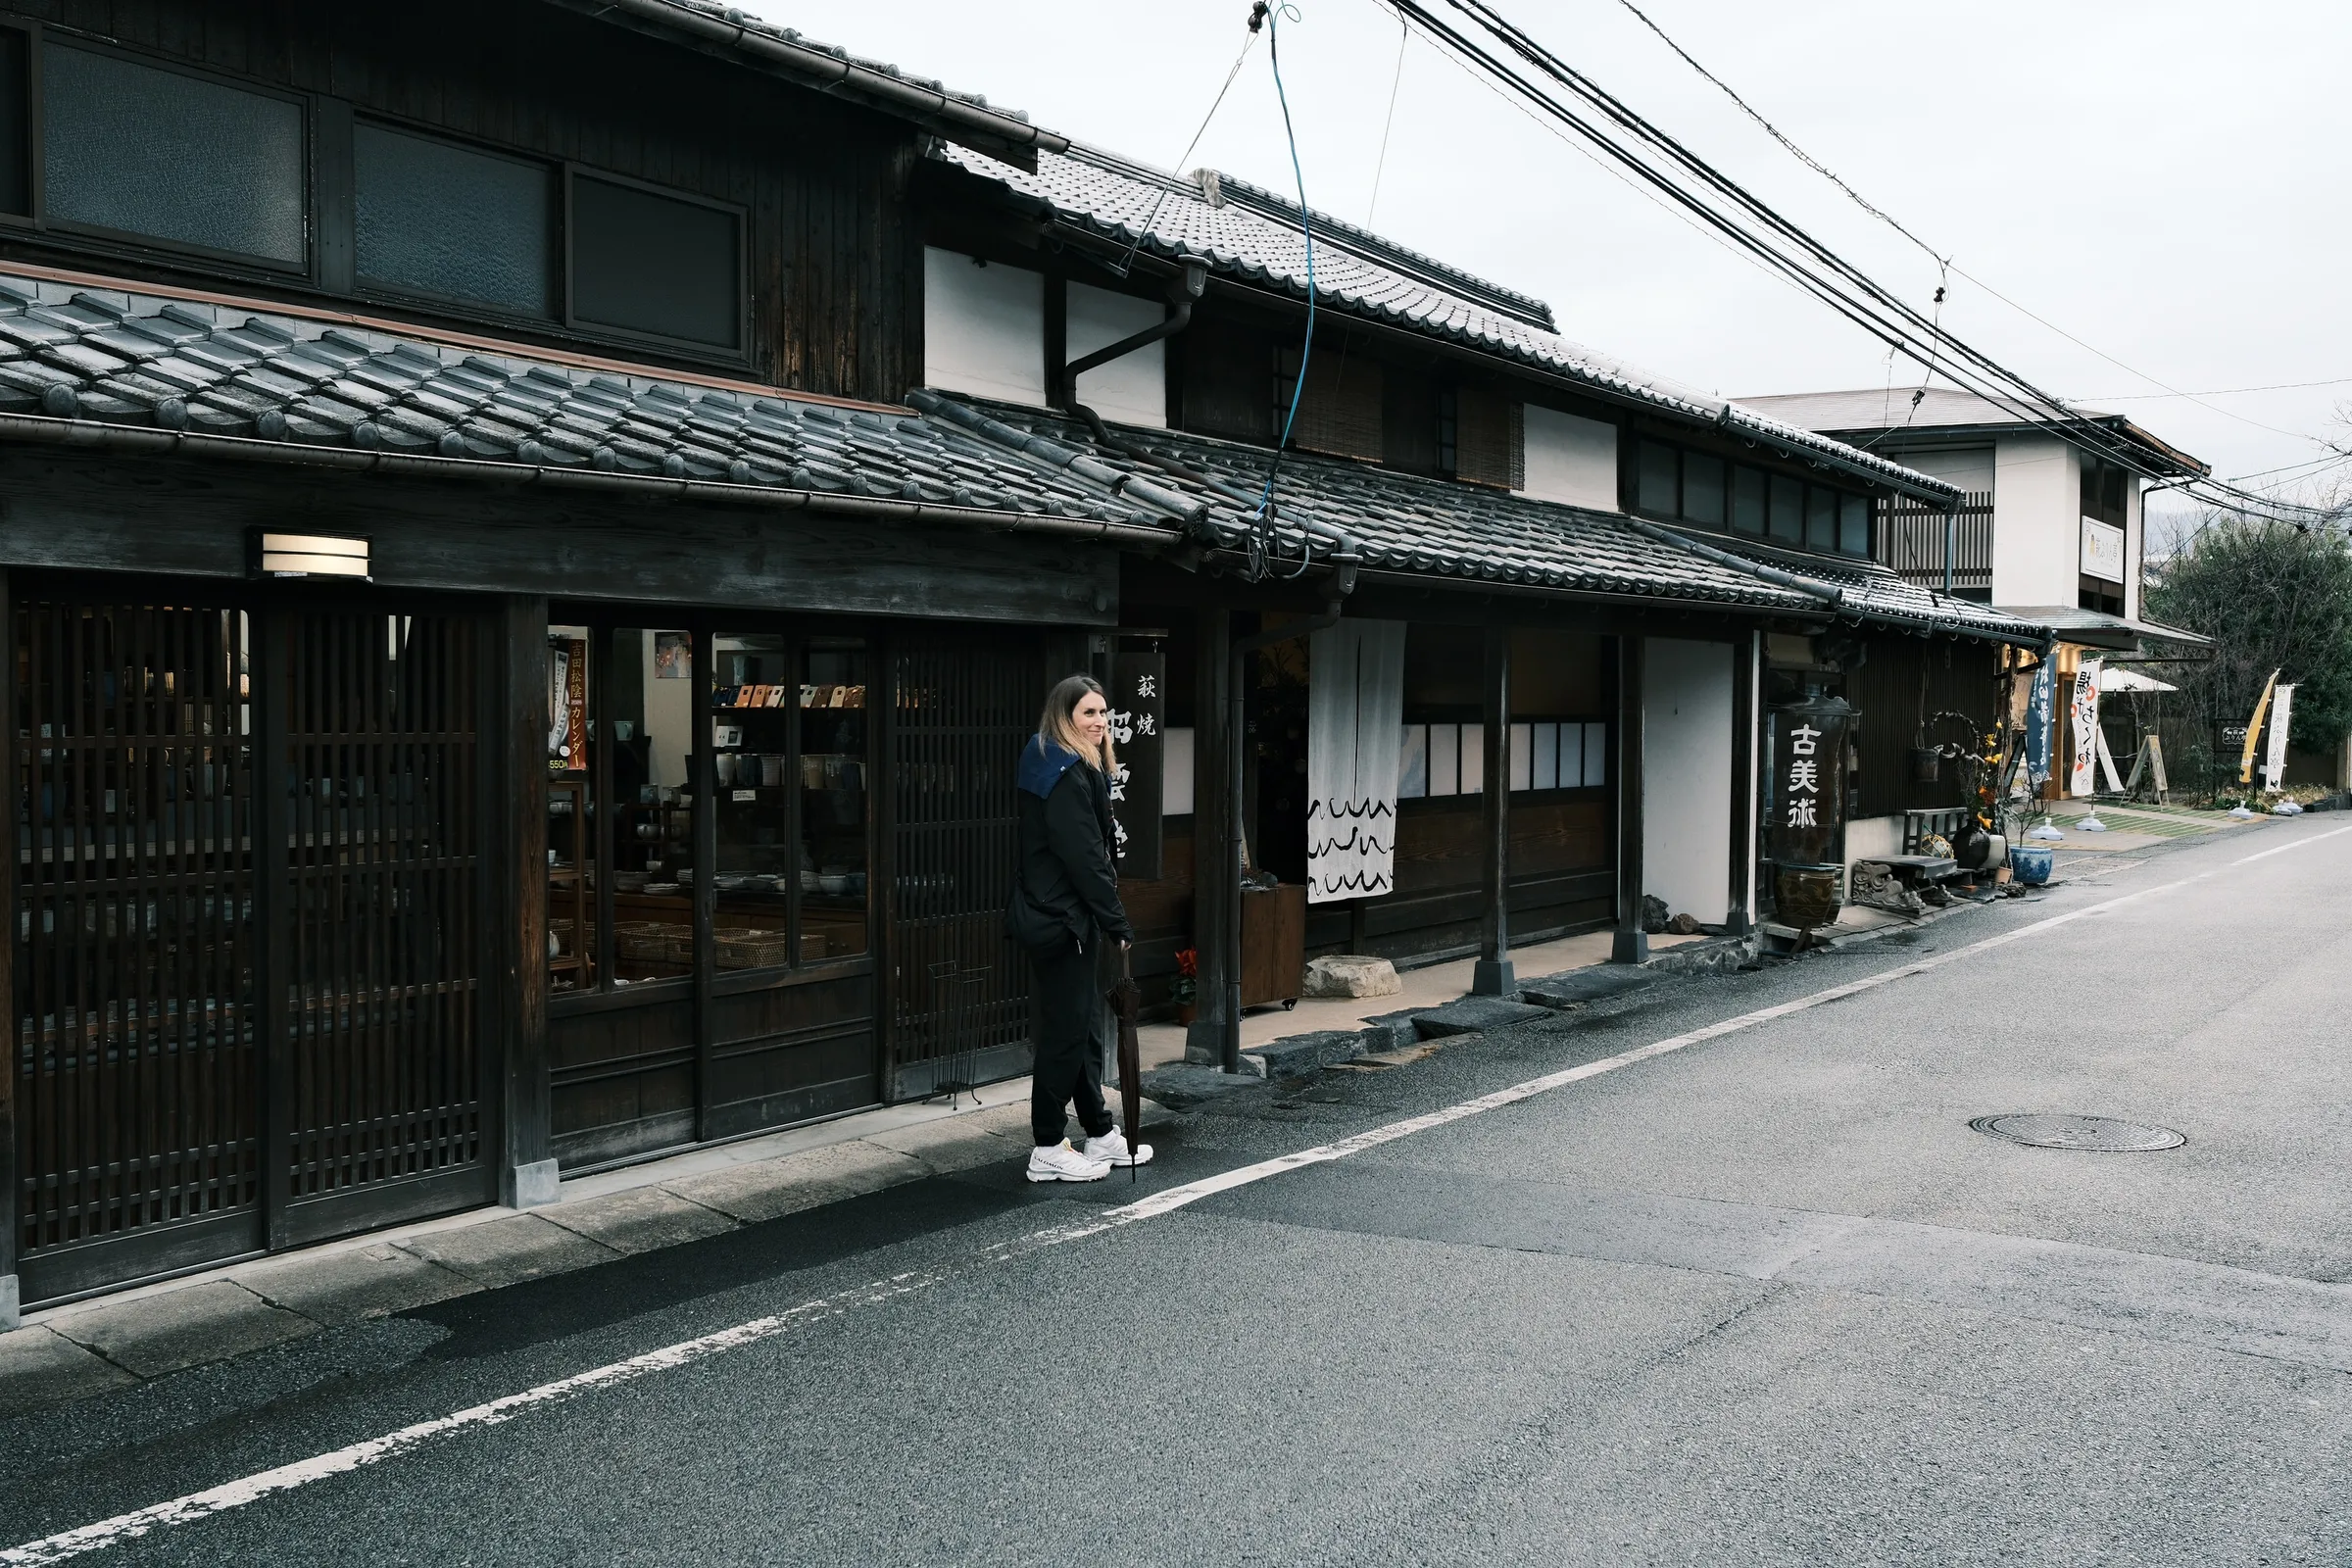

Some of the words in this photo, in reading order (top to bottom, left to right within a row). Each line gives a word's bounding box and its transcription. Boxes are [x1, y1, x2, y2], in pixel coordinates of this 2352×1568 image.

[571, 643, 582, 698] 吉田松陰
[1137, 675, 1156, 736] 萩焼
[571, 708, 583, 766] カレンダー
[1787, 723, 1822, 829] 古美術
